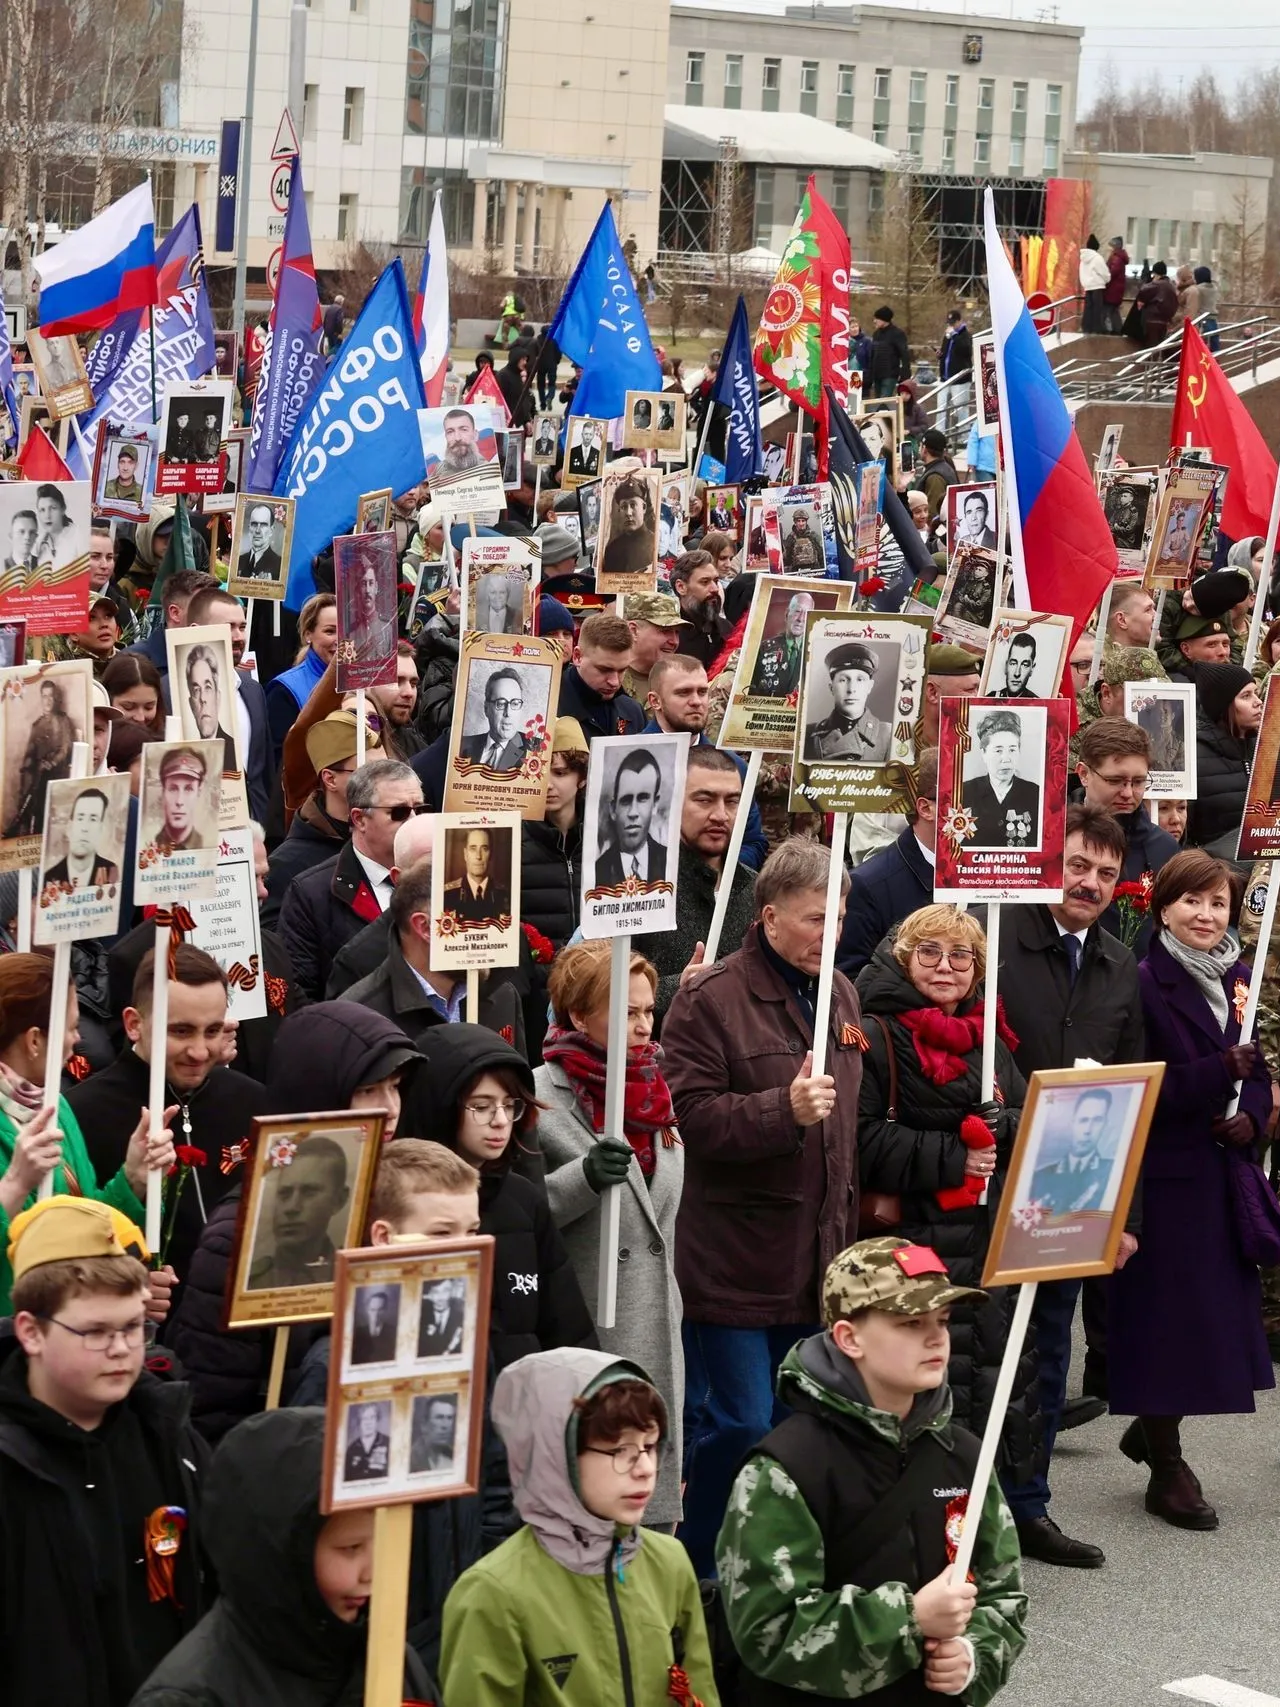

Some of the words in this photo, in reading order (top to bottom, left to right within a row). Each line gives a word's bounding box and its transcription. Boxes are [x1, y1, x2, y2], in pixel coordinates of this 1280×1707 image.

[86, 134, 216, 156] ФЛАРМОНИЯ
[745, 721, 765, 730] Ефим
[764, 722, 796, 732] Лазареви
[808, 768, 876, 781] РЯБЧИКОВ
[452, 782, 472, 790] ЮРИЙ
[473, 784, 511, 793] БОРИСОВИЧ
[512, 787, 541, 796] ЛЕВИТАН
[794, 783, 837, 800] Андрей
[839, 784, 893, 797] Иванович
[827, 799, 856, 807] Капитан
[1250, 828, 1280, 837] РАВИЛЬ
[162, 856, 196, 867] ТУМАНОВ
[971, 853, 1027, 864] САМАРИНА
[140, 871, 170, 882] Алексей
[172, 868, 215, 880] Васильевич
[956, 864, 991, 874] Таисия
[993, 864, 1042, 875] Ивановна
[958, 877, 994, 886] Фельдшер
[995, 876, 1038, 885] медсанбата
[200, 901, 242, 913] ВАСИЛЬЕВИЧ
[593, 903, 620, 916] БИГЛОВ
[621, 899, 666, 914] ХИСМАТУЛЛА
[211, 916, 233, 925] стрелок
[615, 917, 643, 928] 1915-1945
[464, 933, 489, 942] БУКВИЧ
[444, 943, 469, 952] Алексей
[470, 942, 508, 950] Михайлович
